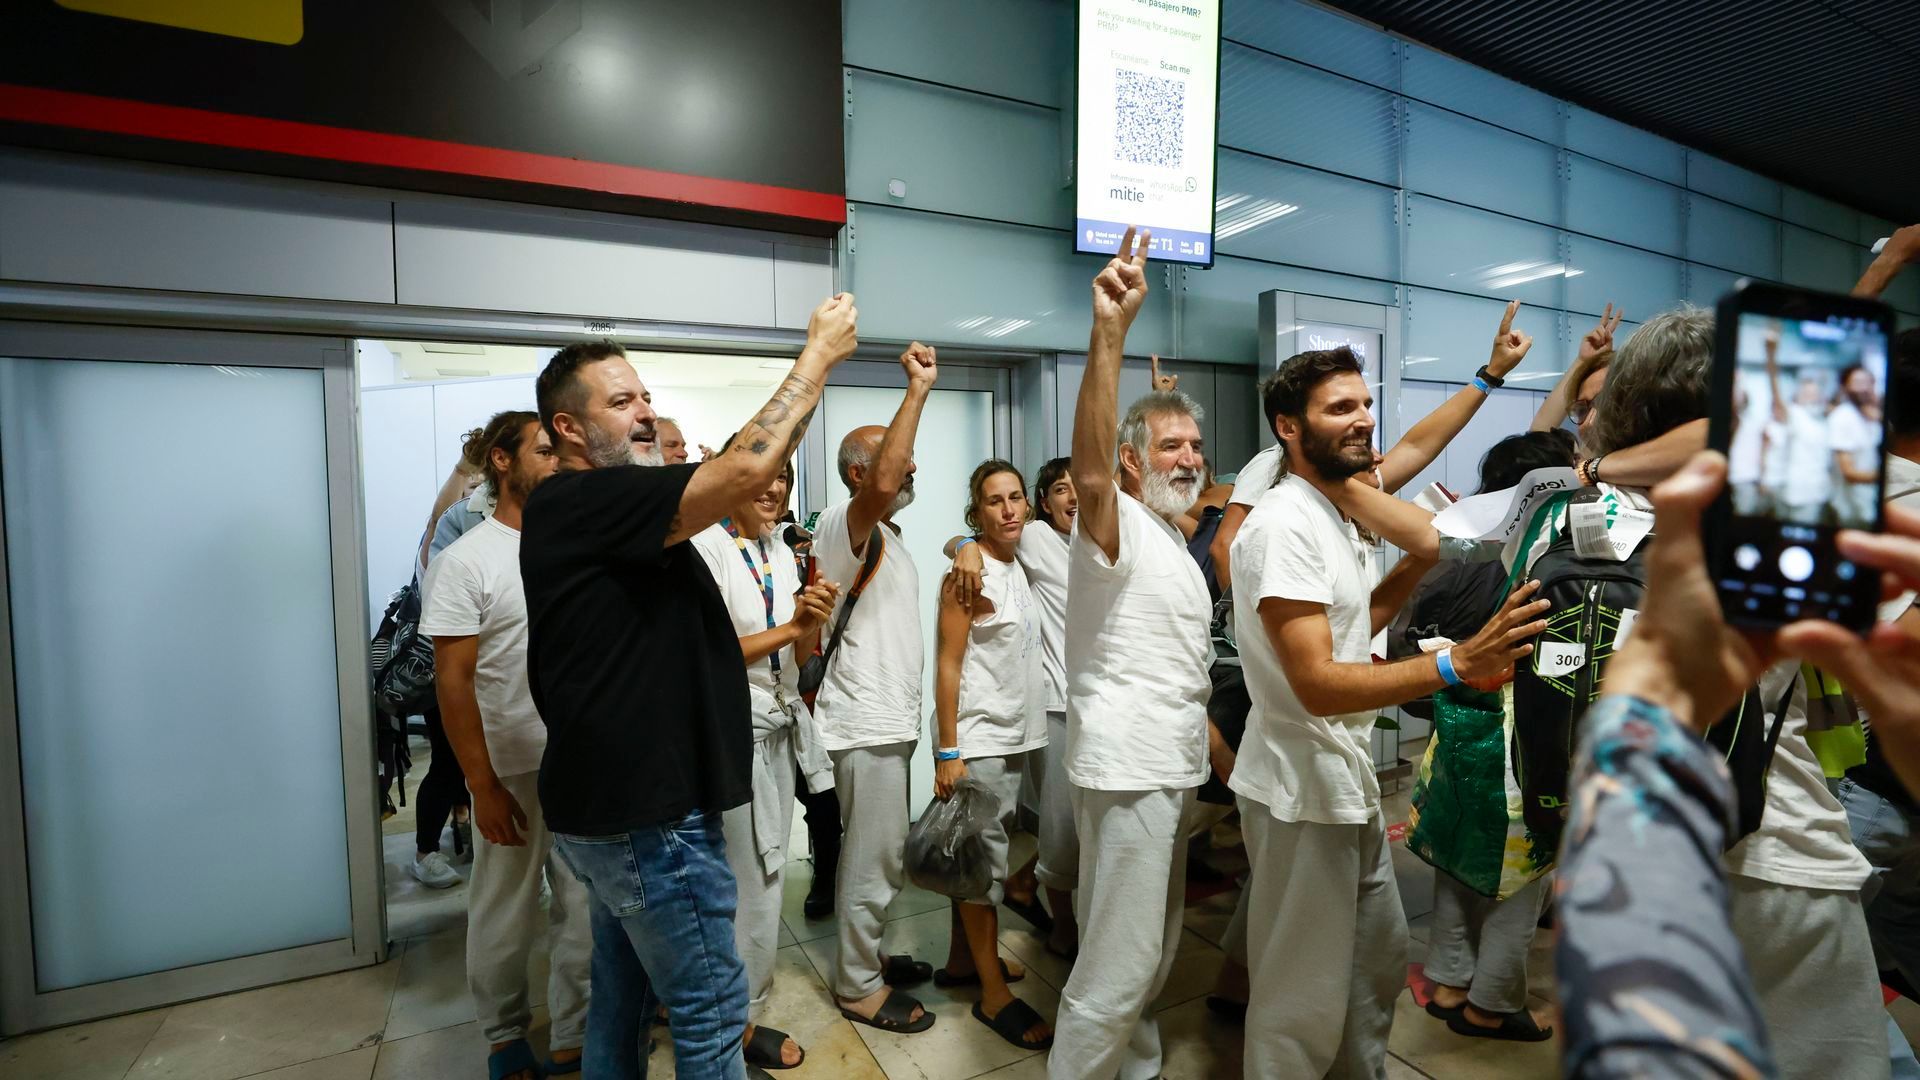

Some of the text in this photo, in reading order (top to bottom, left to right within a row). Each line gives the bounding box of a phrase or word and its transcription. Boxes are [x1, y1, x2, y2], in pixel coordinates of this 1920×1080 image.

[1149, 0, 1180, 12] pasajero
[1181, 5, 1201, 18] PMR?
[1159, 60, 1191, 75] Scan me
[1110, 185, 1145, 203] mitie
[1161, 238, 1173, 251] T1
[590, 322, 611, 332] 2085
[1309, 334, 1366, 357] Shopng
[1555, 654, 1580, 667] 300
